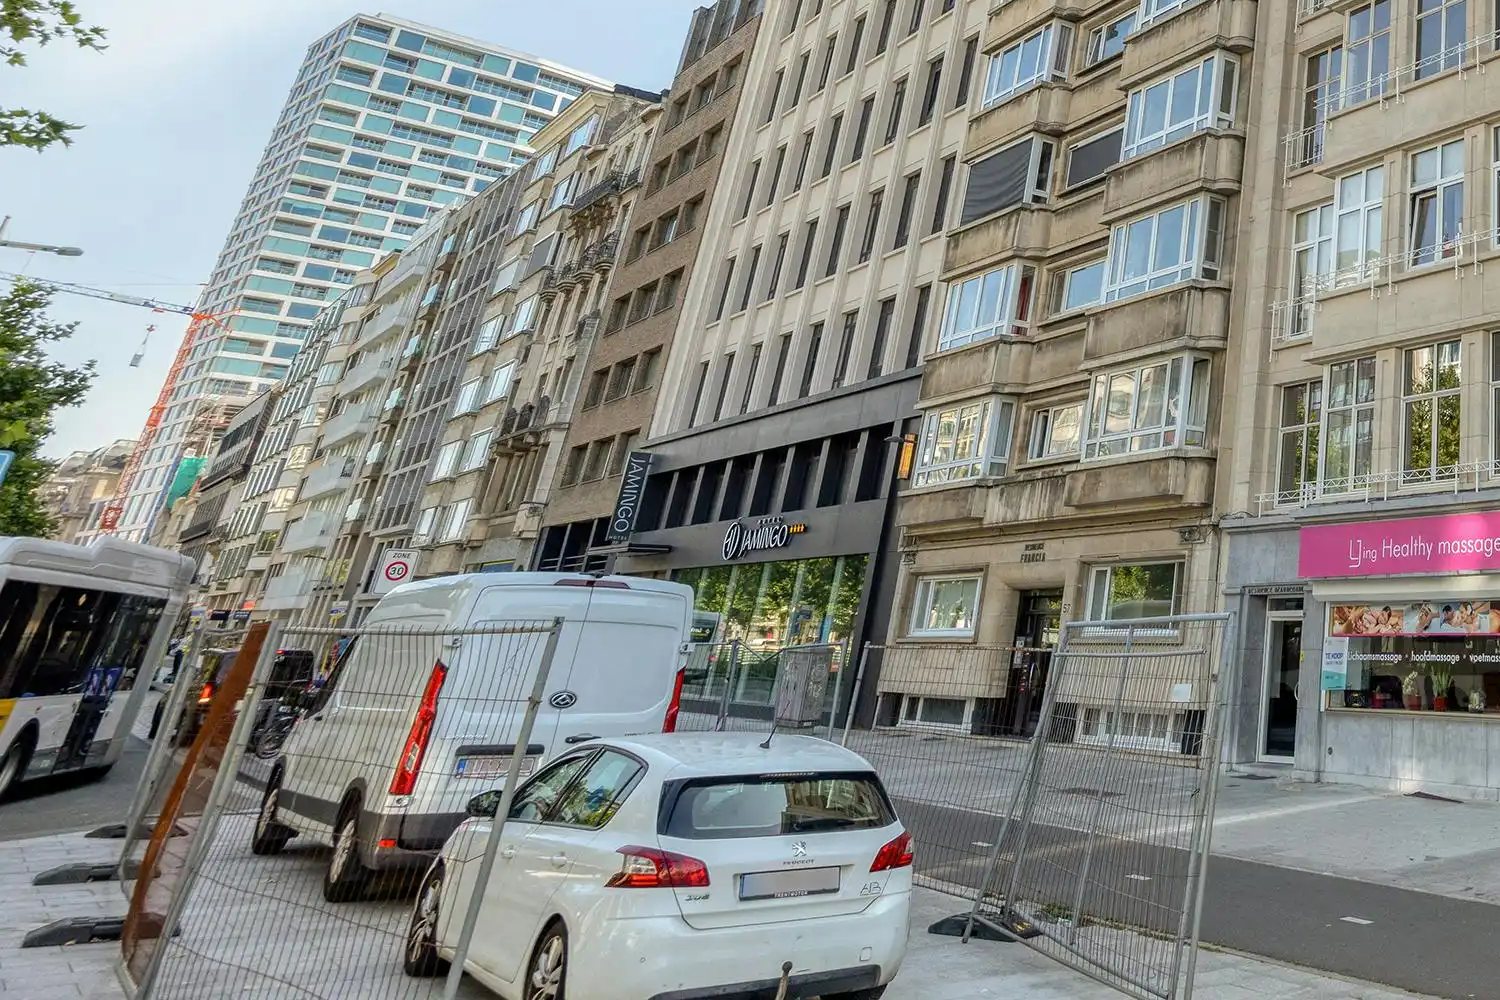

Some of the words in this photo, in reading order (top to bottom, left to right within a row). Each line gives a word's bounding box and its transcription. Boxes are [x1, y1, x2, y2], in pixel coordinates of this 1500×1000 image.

[614, 456, 647, 532] JAMINGO
[738, 524, 788, 558] JAMINGO
[1382, 535, 1433, 561] Healthy
[389, 566, 405, 576] 30
[1411, 650, 1460, 663] hoofdmassage
[782, 858, 815, 866] PEUGEOT
